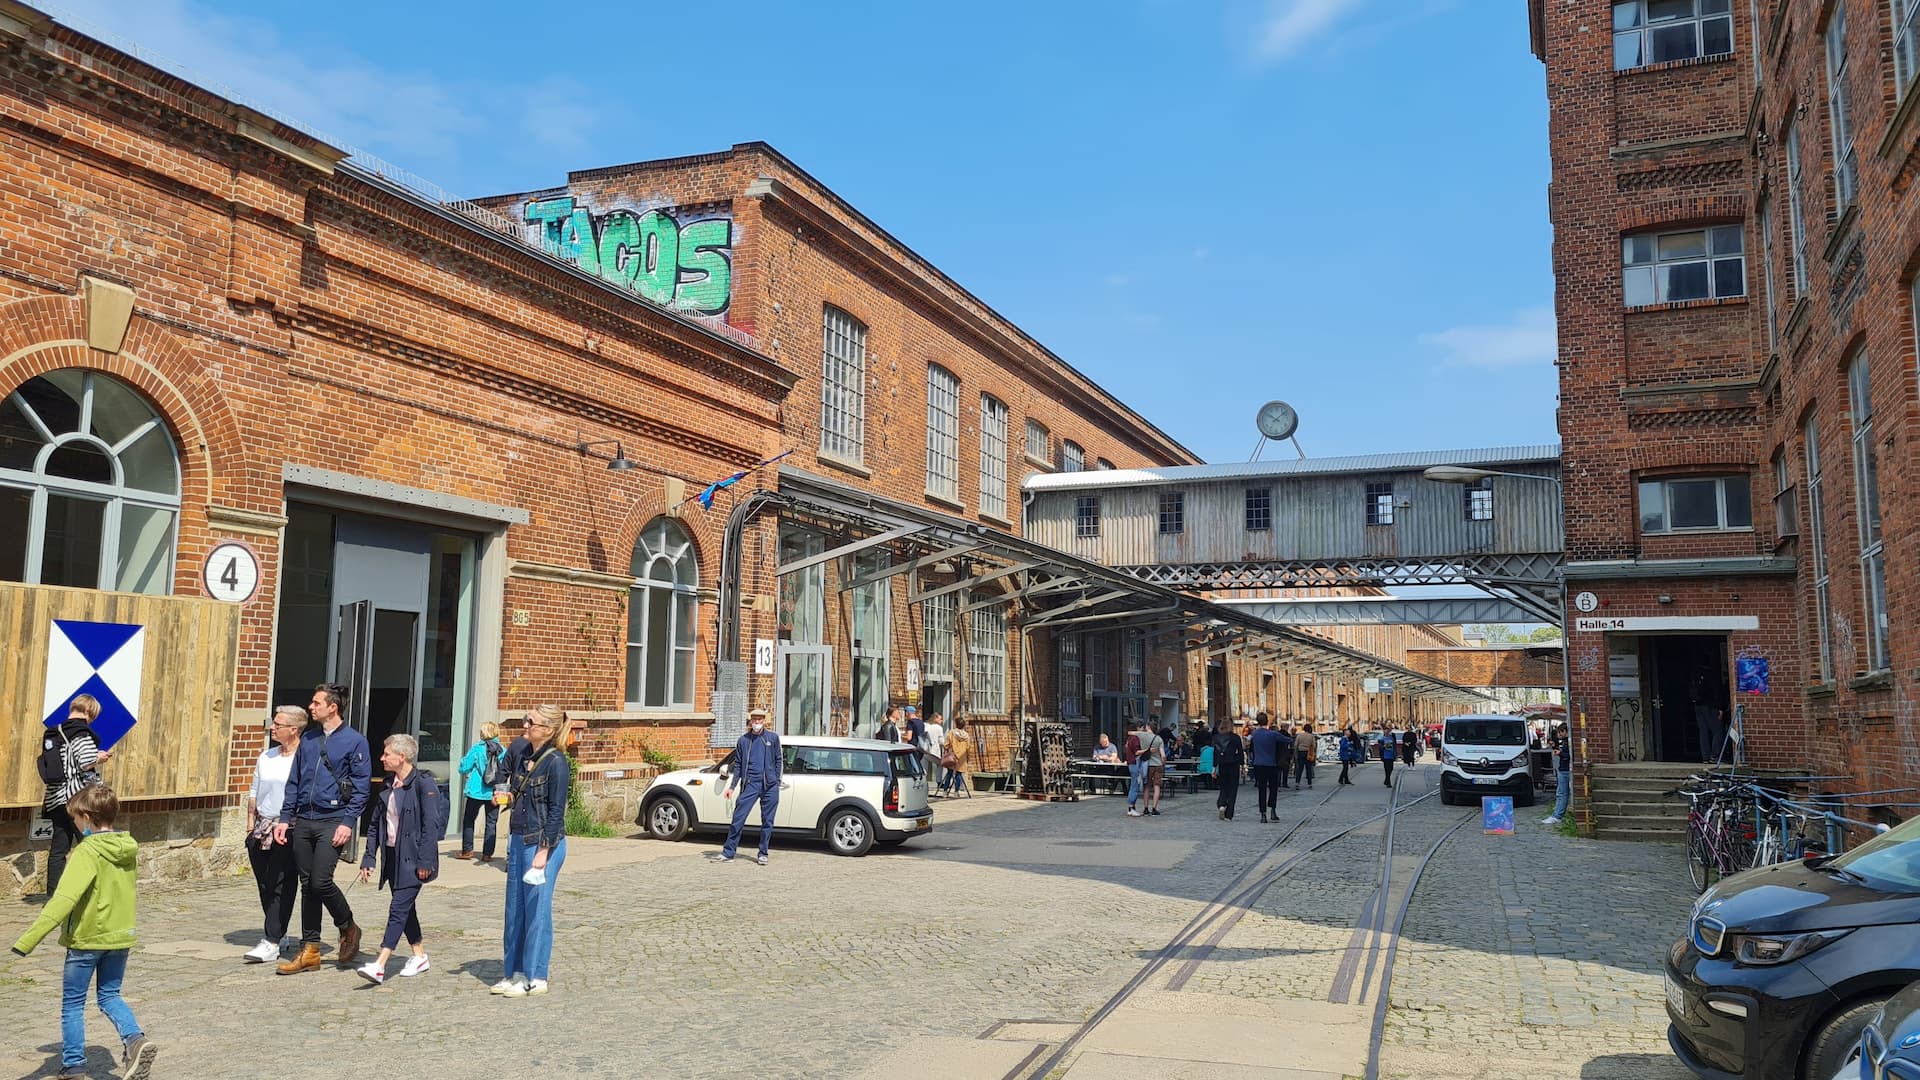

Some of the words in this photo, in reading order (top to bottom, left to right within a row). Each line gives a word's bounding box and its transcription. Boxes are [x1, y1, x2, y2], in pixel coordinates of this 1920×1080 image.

[524, 197, 733, 317] TACOS
[220, 556, 239, 592] 4
[1581, 599, 1592, 610] B
[1580, 619, 1608, 629] Halle
[1610, 619, 1625, 629] 14
[758, 645, 771, 667] 13
[909, 667, 918, 685] 12
